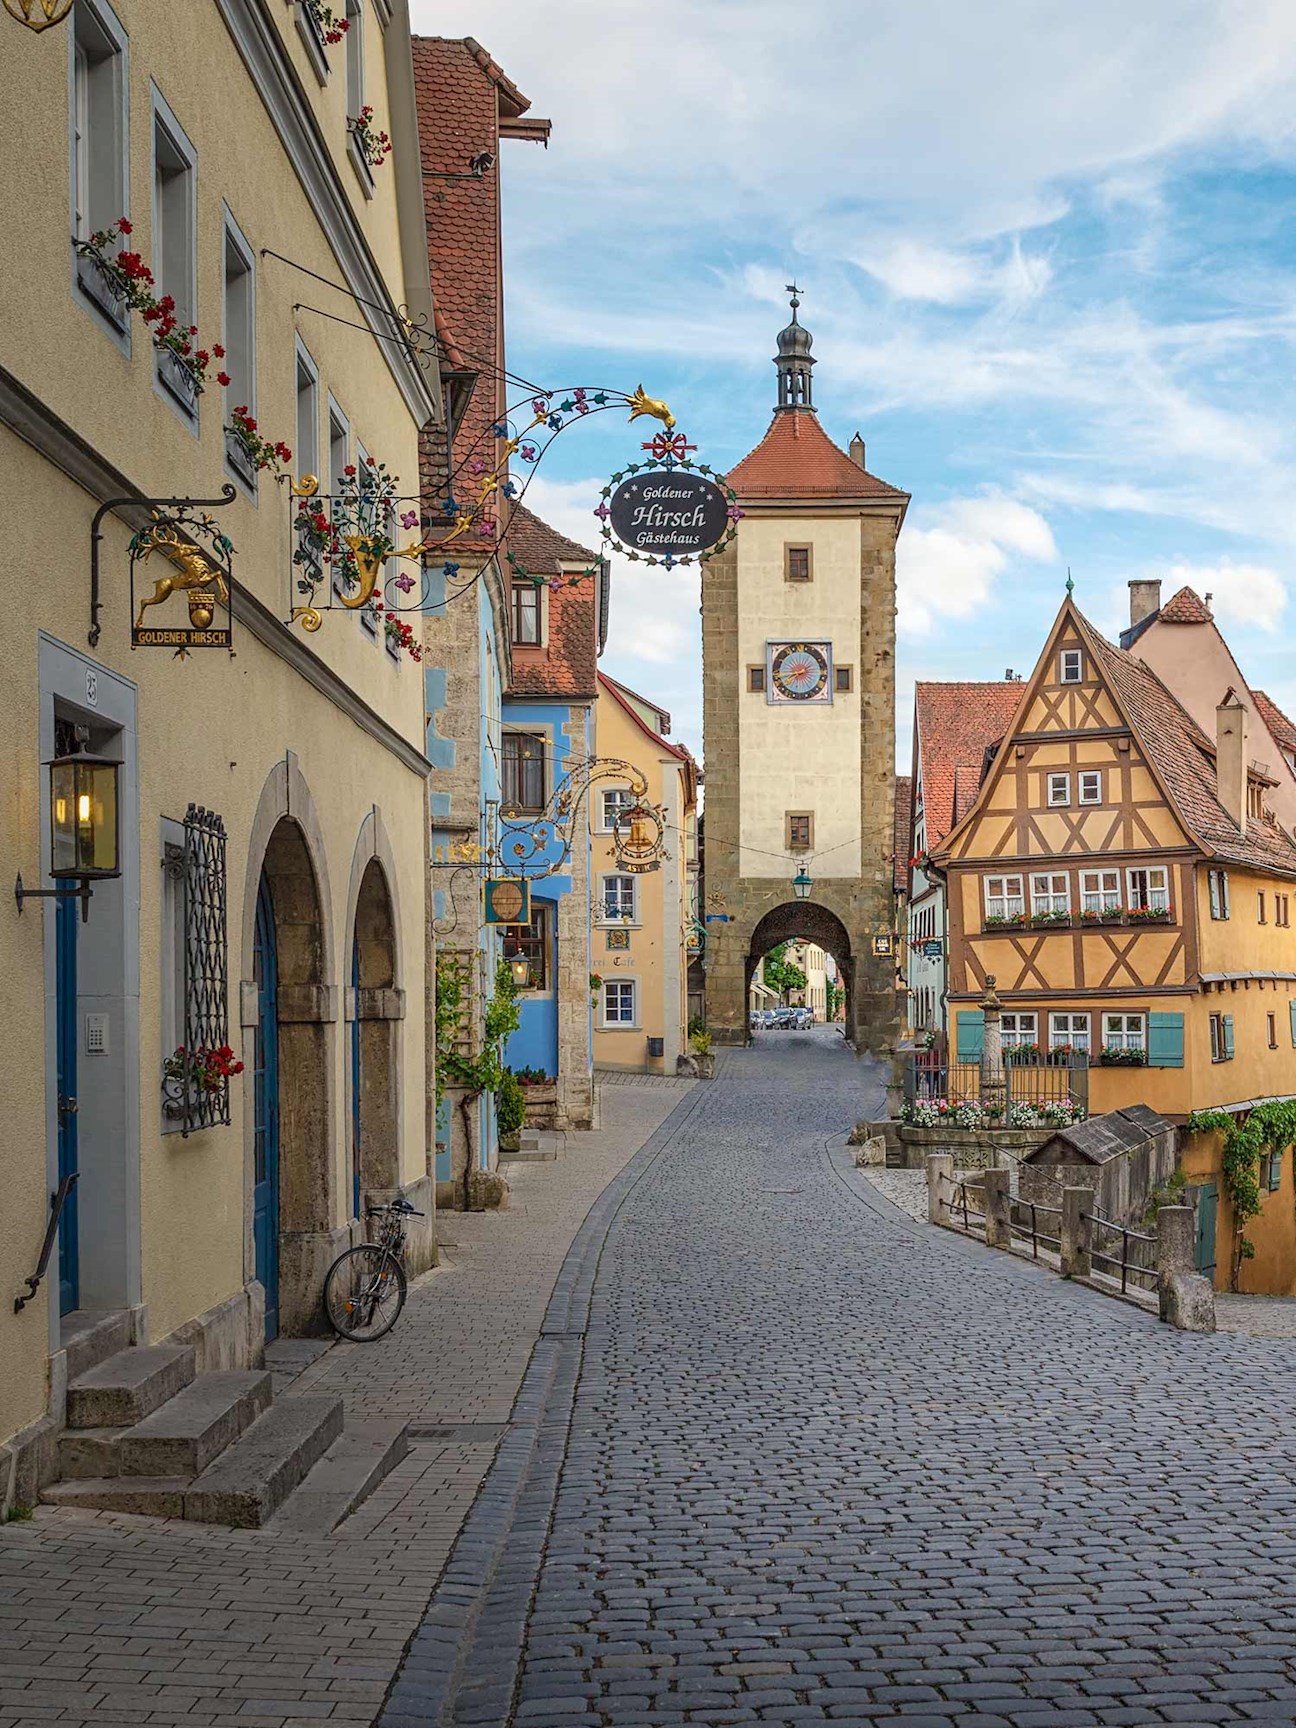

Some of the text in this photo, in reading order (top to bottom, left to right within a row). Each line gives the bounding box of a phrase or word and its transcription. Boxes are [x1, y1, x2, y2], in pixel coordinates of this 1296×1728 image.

[643, 486, 693, 501] Goldener
[631, 504, 706, 527] Hirsch
[636, 531, 700, 546] Gästehaus
[138, 632, 226, 644] GOLDENER HIRSCH
